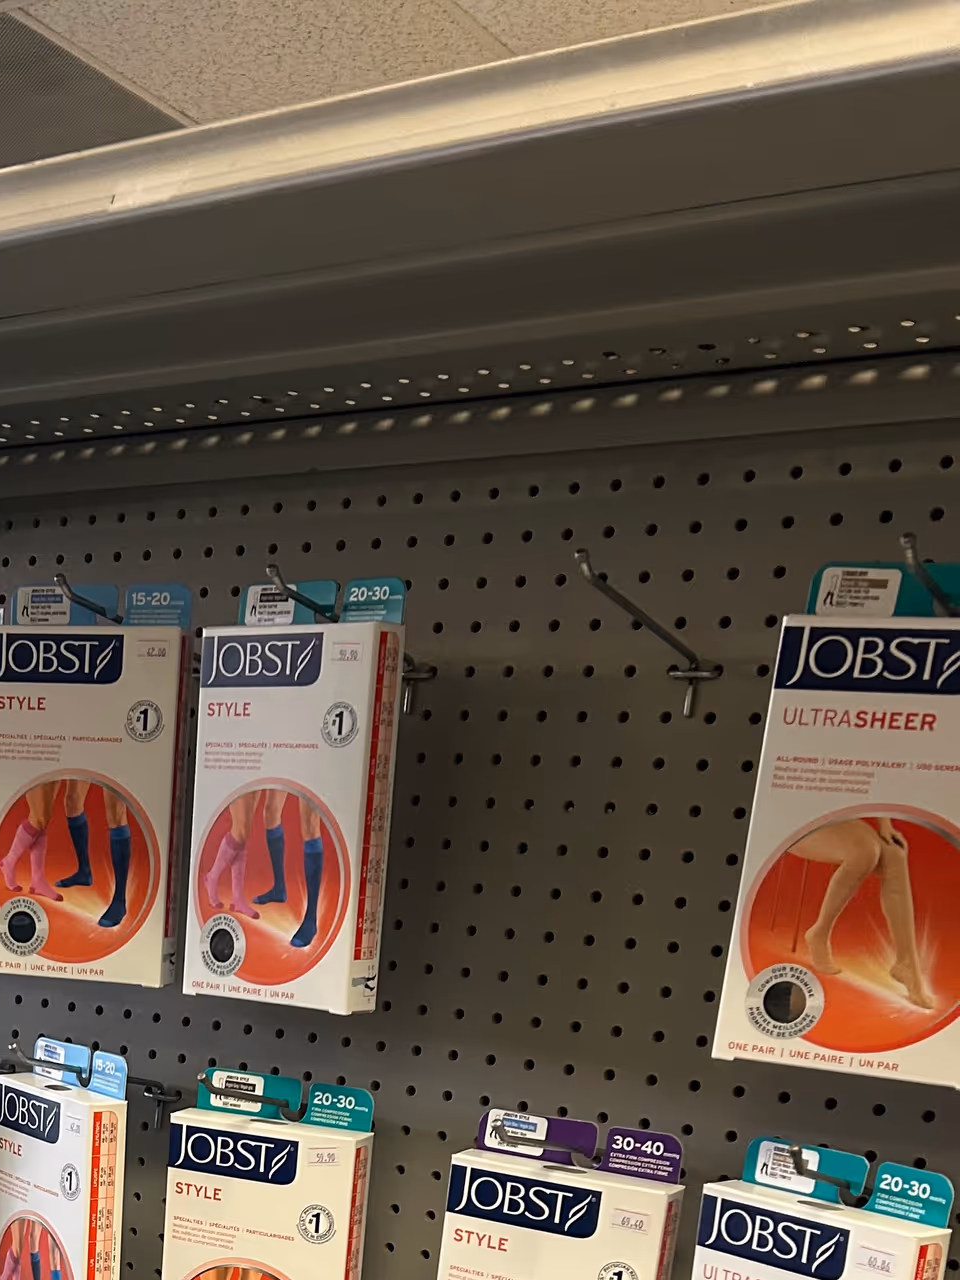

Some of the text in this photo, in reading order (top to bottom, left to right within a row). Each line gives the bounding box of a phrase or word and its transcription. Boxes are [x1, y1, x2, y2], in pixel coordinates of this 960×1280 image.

[132, 592, 170, 606] 15-20
[350, 586, 389, 601] 20-30
[208, 636, 300, 685] JOBST
[785, 626, 950, 686] JOBST
[207, 702, 251, 717] STYLE
[783, 707, 937, 732] ULTRASHEER
[30, 964, 45, 972] UNE
[47, 965, 68, 973] PAIRE
[206, 982, 221, 990] PAIR
[228, 985, 241, 993] UNE
[243, 987, 262, 996] PAIRE
[270, 991, 279, 999] UN
[281, 992, 295, 1000] PAR
[728, 1041, 899, 1072] ONE PAIR UNE PAIRE UN PAR
[0, 1084, 48, 1132] JOBST
[313, 1091, 356, 1109] 20-30
[0, 1138, 22, 1157] STYLE
[175, 1124, 275, 1173] JOBST
[612, 1135, 664, 1156] 30-40
[175, 1182, 222, 1201] STYLE
[455, 1166, 574, 1224] JOBST
[879, 1173, 931, 1199] 20-30
[620, 1216, 644, 1230] 69.40
[705, 1197, 821, 1265] JOBST
[453, 1228, 509, 1252] STYLE
[449, 1265, 484, 1278] SPECIALTIES
